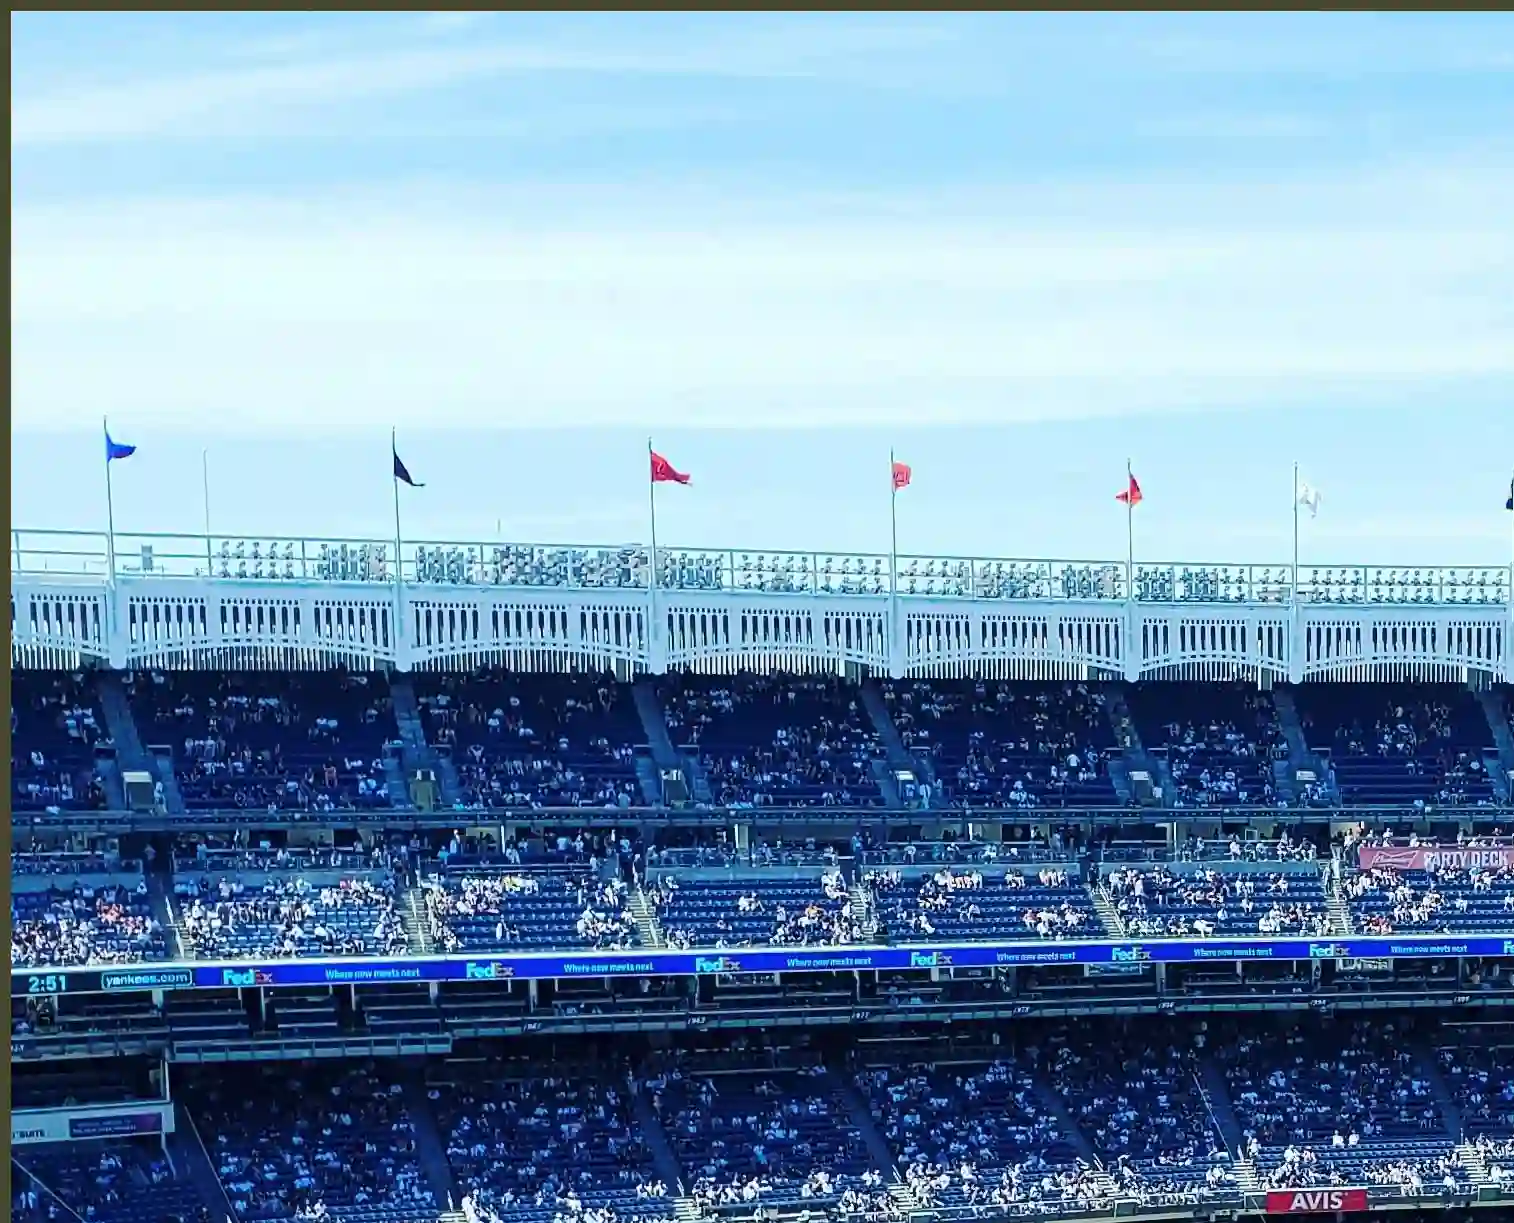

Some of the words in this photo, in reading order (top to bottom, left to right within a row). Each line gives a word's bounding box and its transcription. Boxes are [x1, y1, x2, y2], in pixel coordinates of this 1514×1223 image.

[1424, 848, 1469, 867] PARTY
[1471, 848, 1509, 867] DECK
[1112, 947, 1151, 962] FedEx
[1309, 943, 1349, 958] FedEx
[696, 957, 740, 972] FedEx
[911, 951, 952, 966] FedEx
[223, 969, 273, 985] FedEx
[466, 961, 514, 979] FedEx
[29, 975, 66, 993] 2:51
[106, 973, 188, 987] yankees.com
[1290, 1192, 1344, 1210] AVIS
